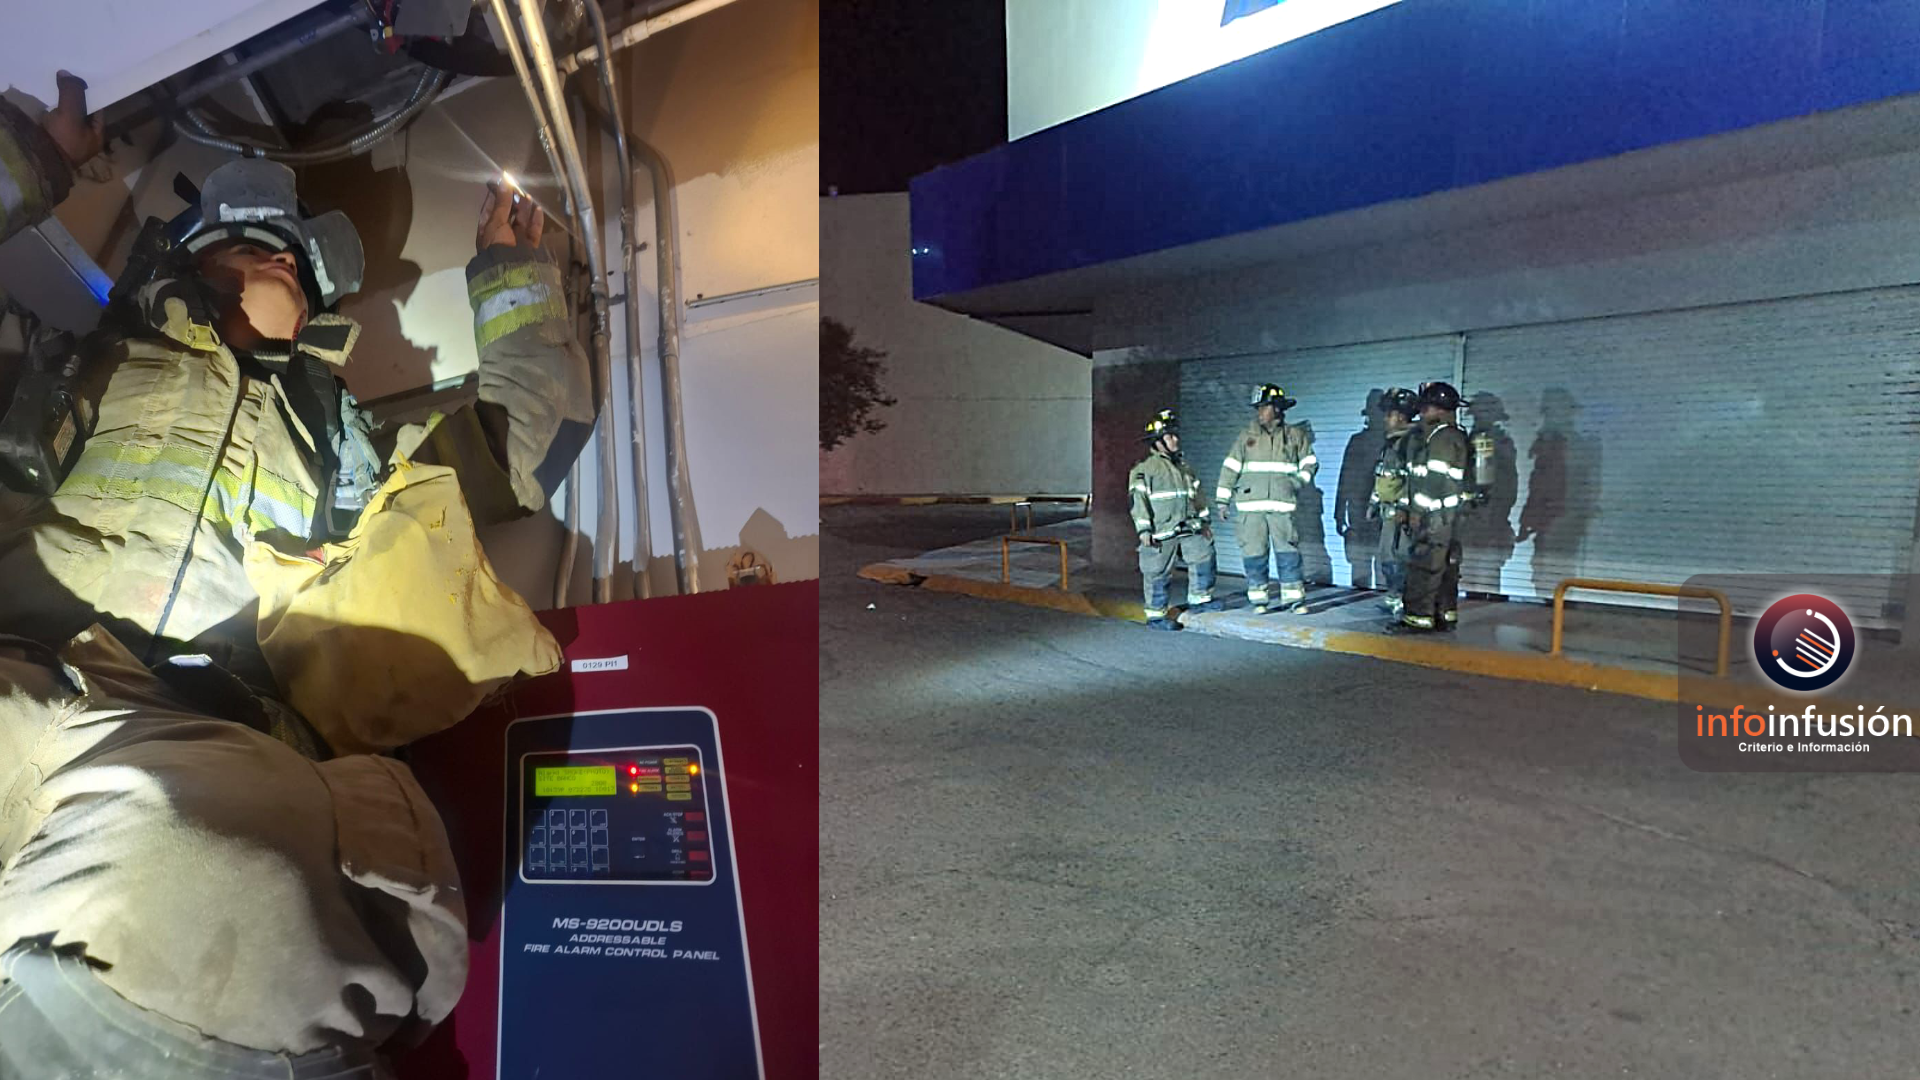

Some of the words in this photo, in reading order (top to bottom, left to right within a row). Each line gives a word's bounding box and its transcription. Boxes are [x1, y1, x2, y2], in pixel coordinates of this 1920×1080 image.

[582, 661, 603, 669] 0129
[552, 917, 683, 933] MS-9200UDLS
[569, 933, 667, 946] ADDRESSABLE
[523, 943, 551, 953] FIRE
[554, 945, 601, 956] ALARM
[605, 947, 668, 959] CONTROL
[673, 950, 720, 961] PANEL
